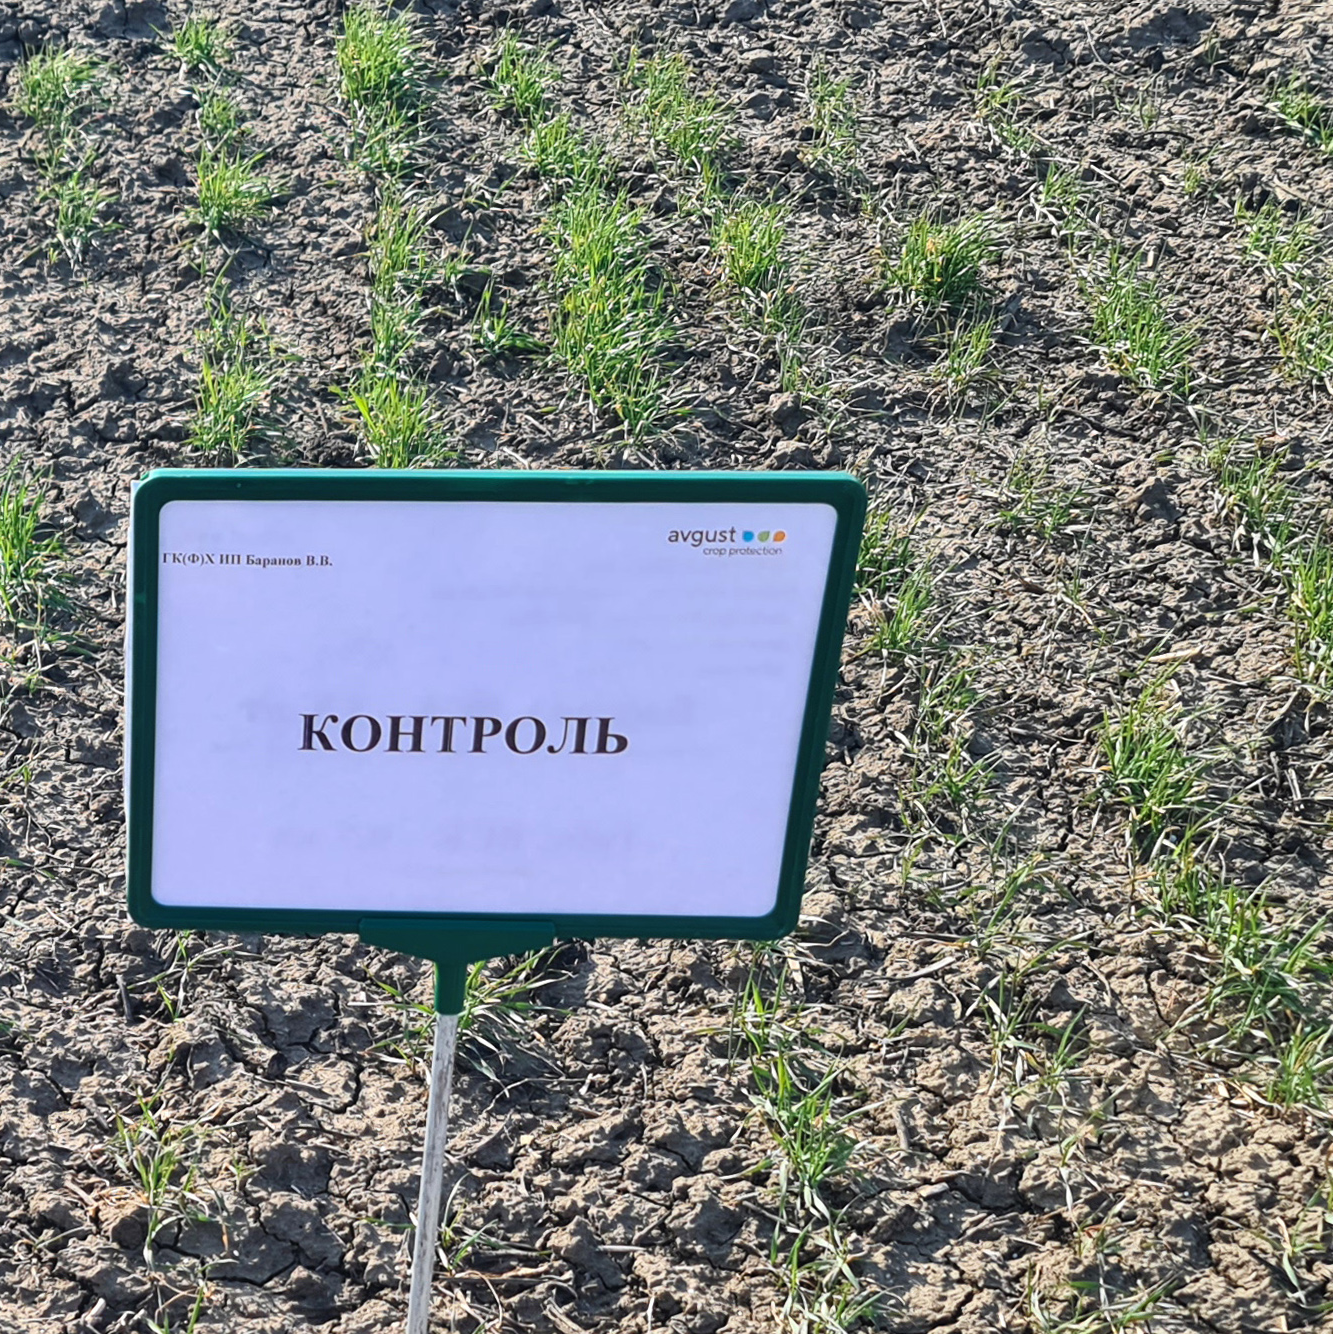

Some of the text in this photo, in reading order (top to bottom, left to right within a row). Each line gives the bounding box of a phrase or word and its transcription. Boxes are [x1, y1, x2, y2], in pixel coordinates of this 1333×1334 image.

[667, 526, 737, 547] avgust
[219, 553, 241, 565] ИП
[246, 554, 302, 569] Баранов
[306, 555, 333, 567] В.В.
[702, 547, 783, 557] crop protection
[297, 713, 629, 755] КОНТРОЛЬ
